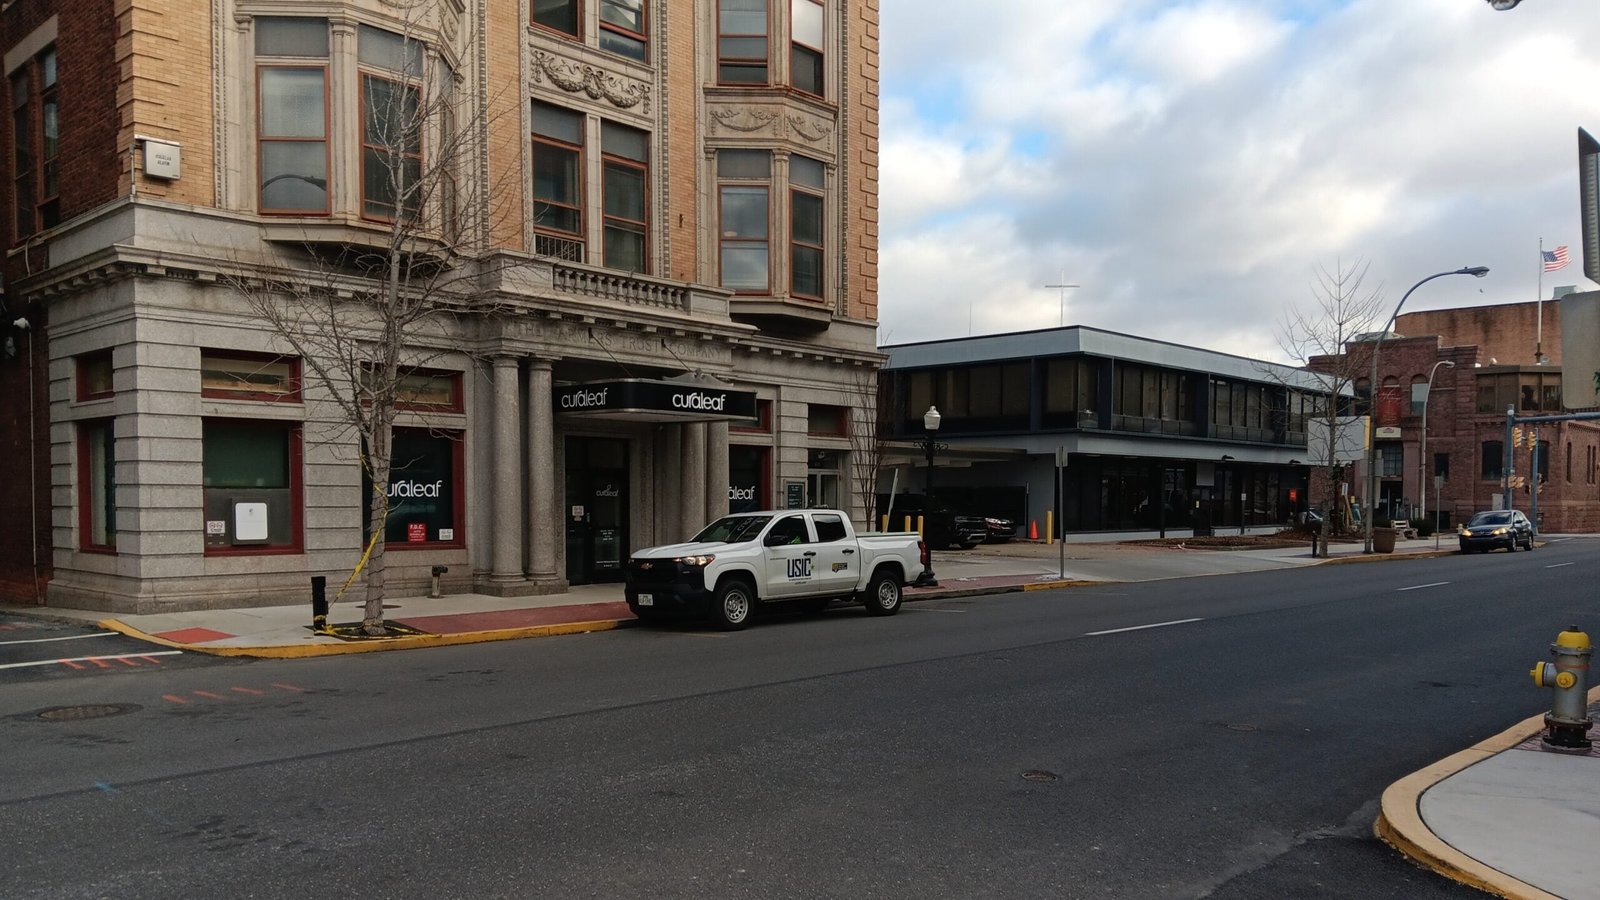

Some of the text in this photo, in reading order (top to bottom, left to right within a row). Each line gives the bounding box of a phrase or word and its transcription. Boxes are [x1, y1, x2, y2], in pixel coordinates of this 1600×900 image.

[622, 337, 660, 353] TRUST
[669, 342, 722, 359] COMPANY
[561, 387, 608, 408] curaleaf
[672, 391, 726, 411] curaleaf
[387, 479, 443, 498] uraleaf
[728, 485, 755, 500] aleaf
[787, 558, 812, 578] USIC
